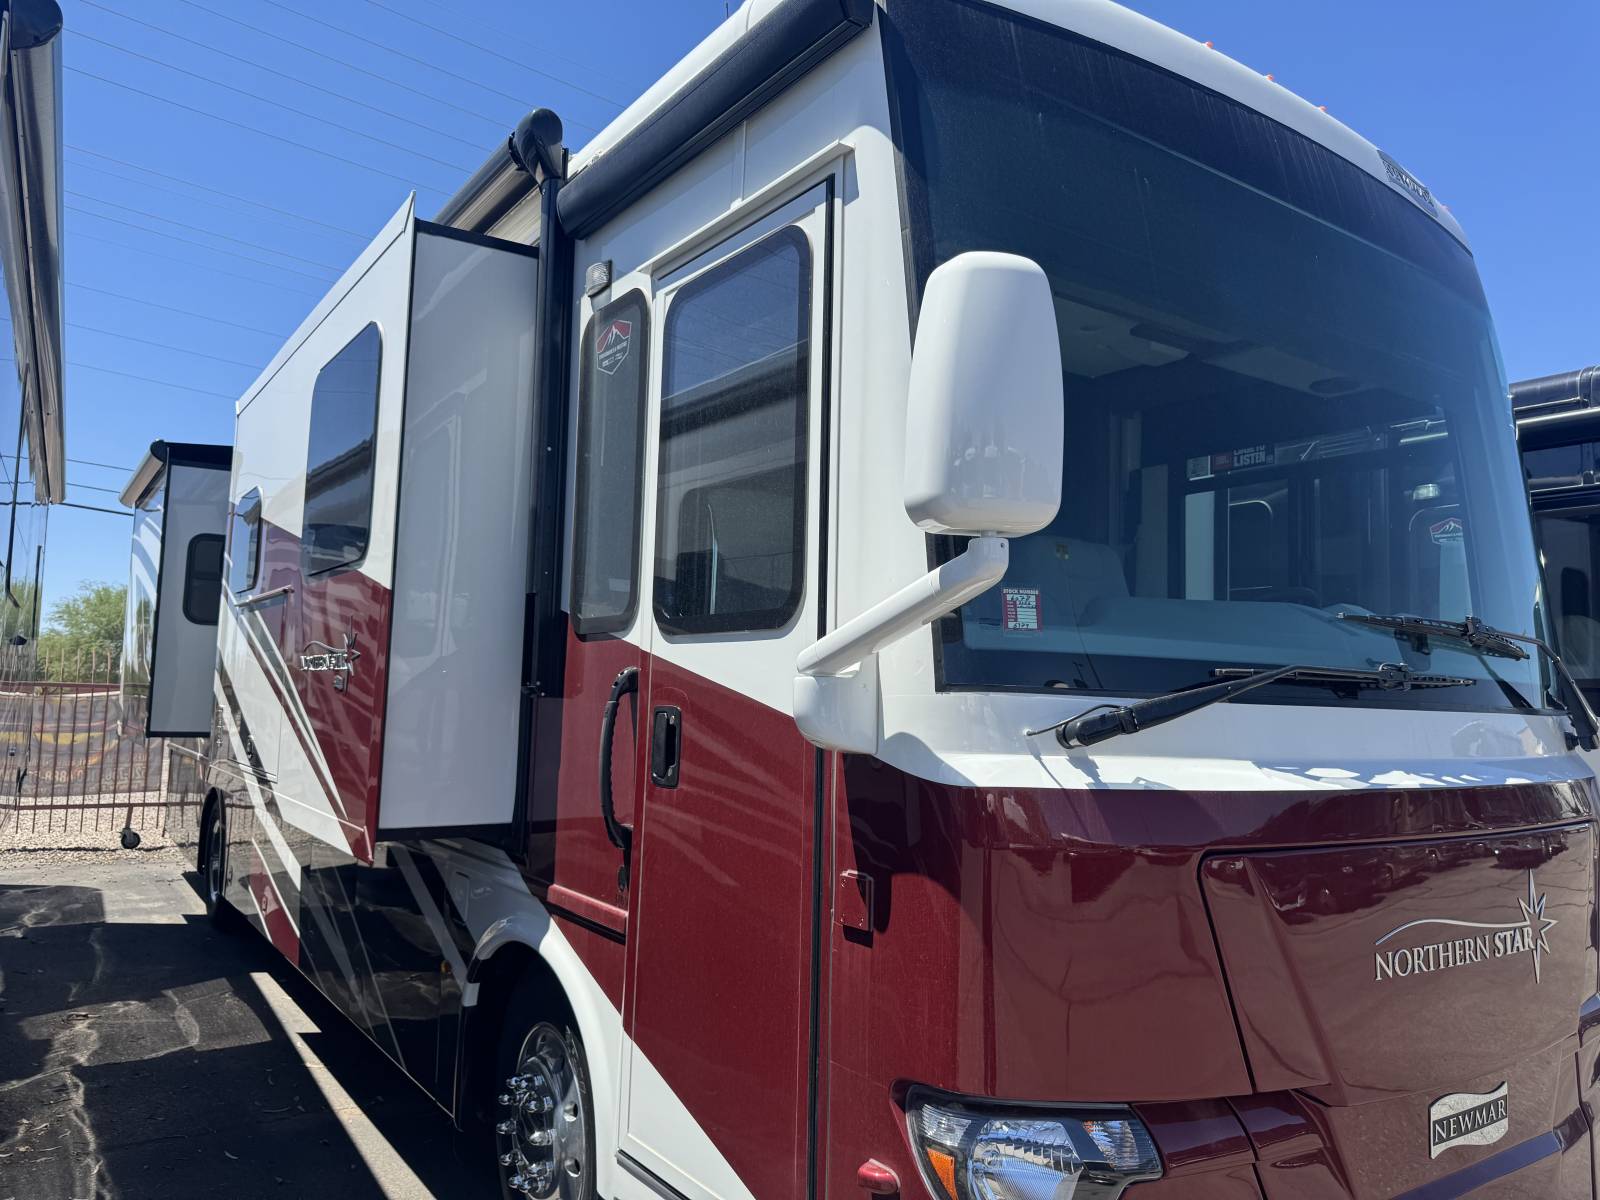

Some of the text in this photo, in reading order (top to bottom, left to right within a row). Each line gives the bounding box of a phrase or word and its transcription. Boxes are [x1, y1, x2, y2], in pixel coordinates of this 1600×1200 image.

[1374, 926, 1536, 981] NORTHERN STAR
[1434, 1099, 1506, 1143] NEWMAR
